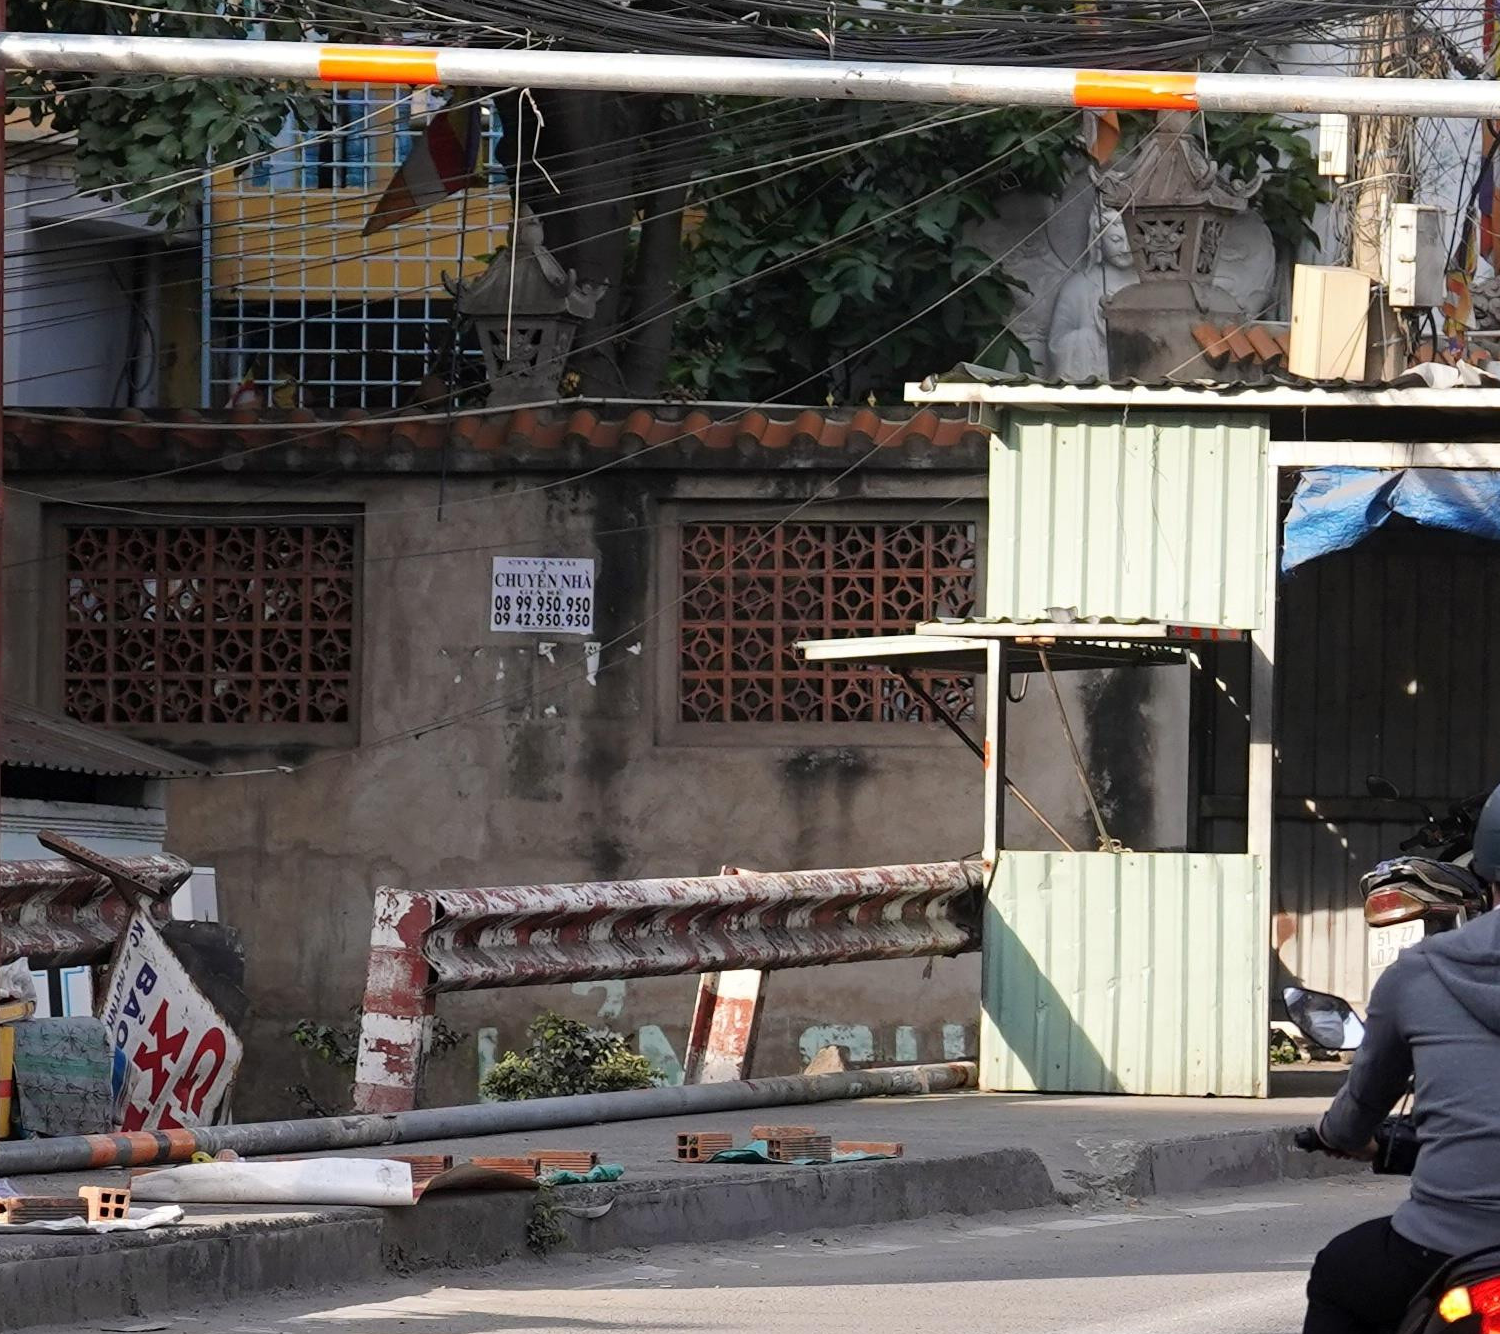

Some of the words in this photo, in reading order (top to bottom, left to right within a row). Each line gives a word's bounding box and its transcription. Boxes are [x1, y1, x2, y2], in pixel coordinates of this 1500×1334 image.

[561, 570, 591, 589] NHÀ
[494, 595, 511, 612] 08
[516, 595, 590, 613] 99.950.950
[494, 612, 510, 625] 09
[515, 613, 590, 627] 42.950.950
